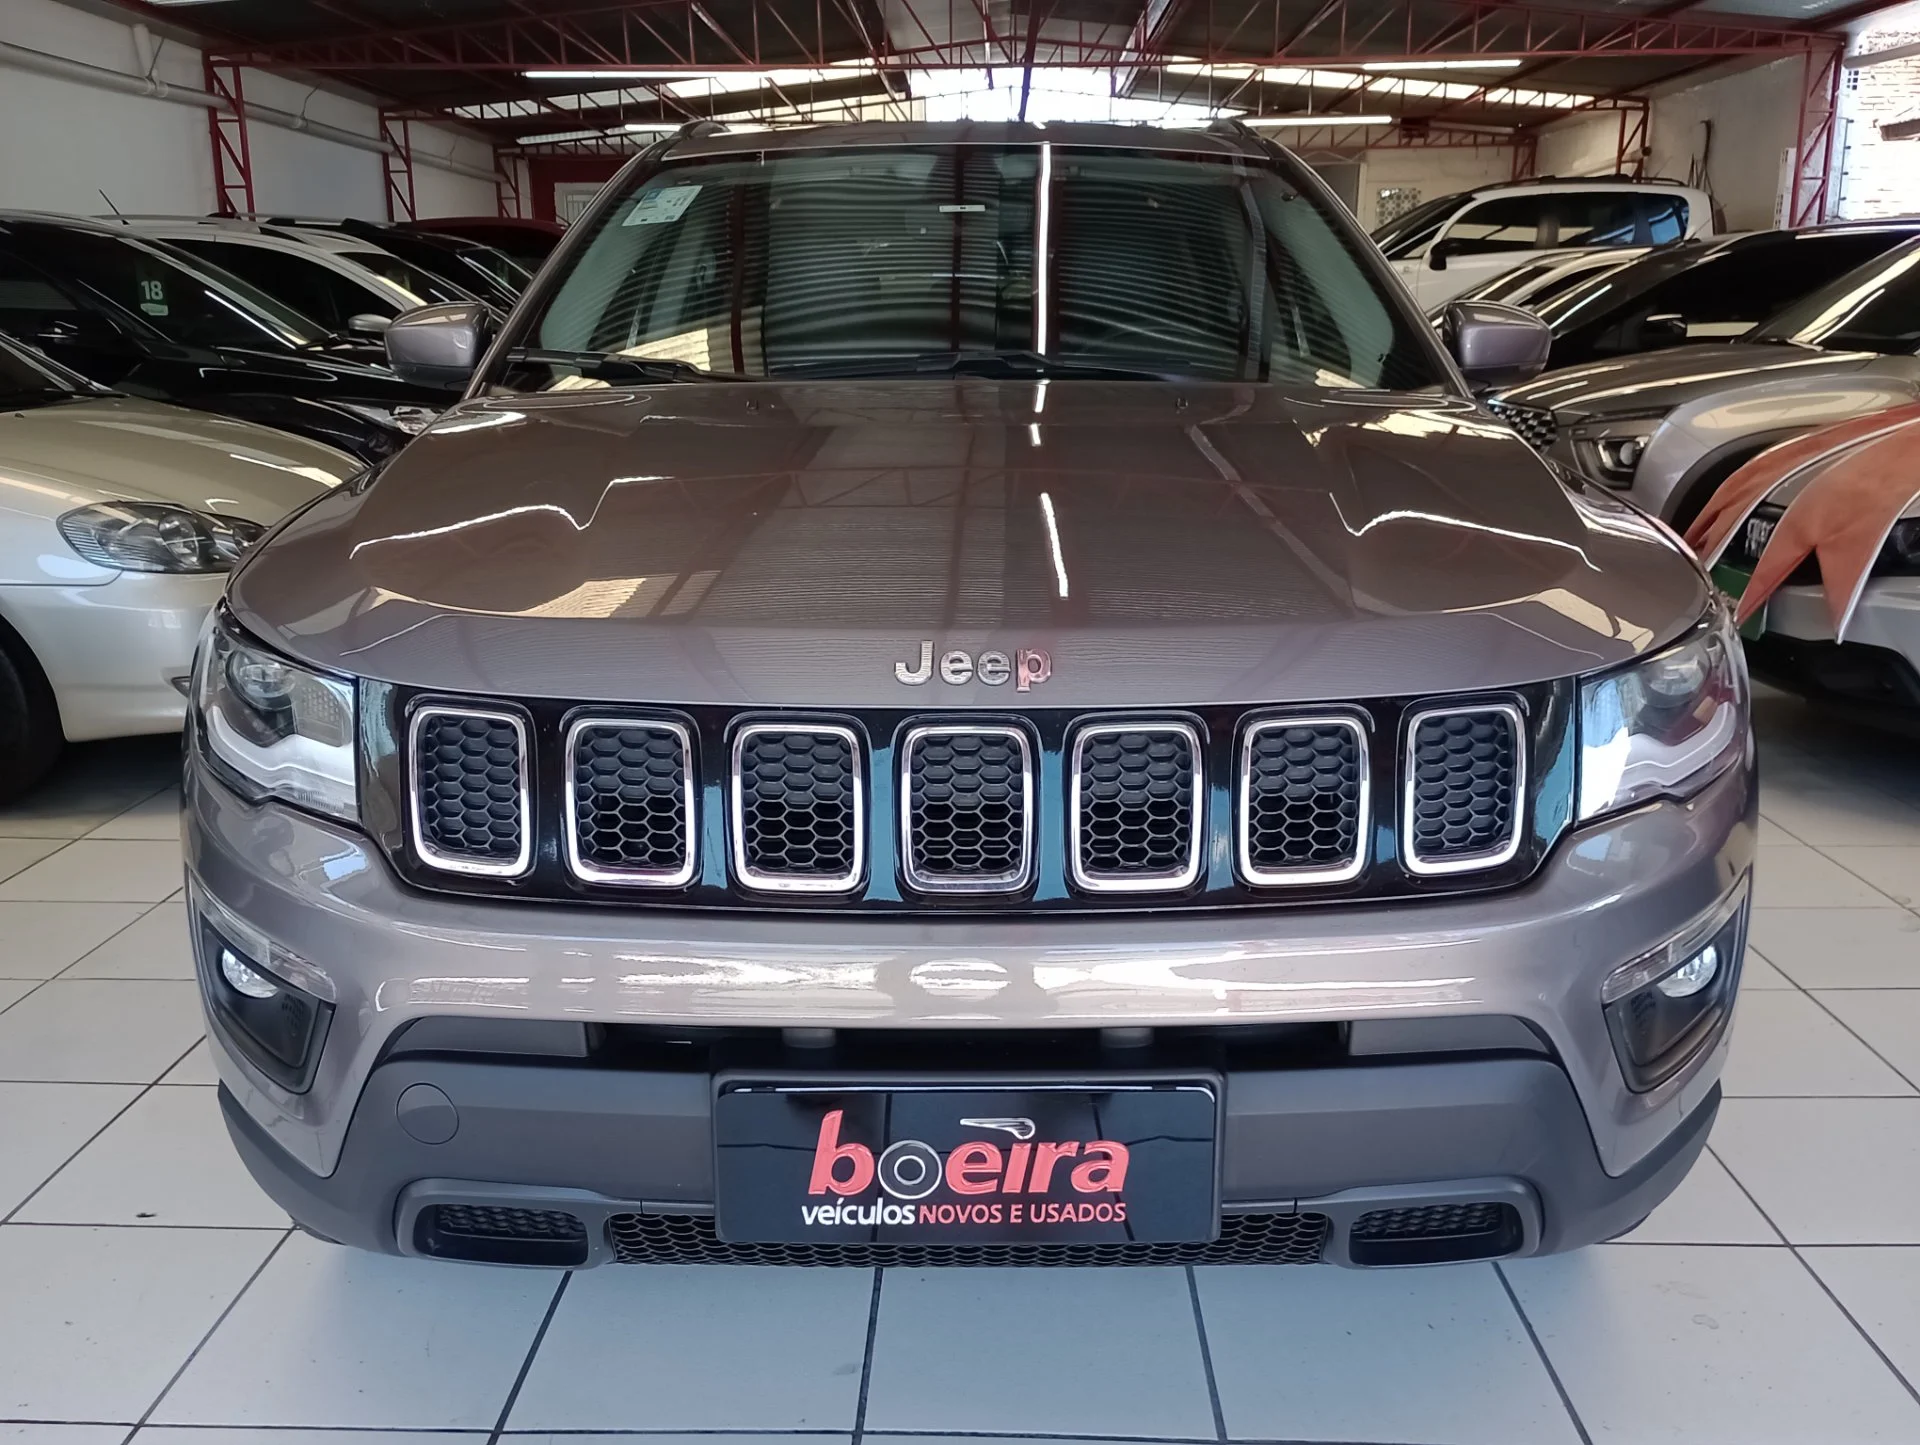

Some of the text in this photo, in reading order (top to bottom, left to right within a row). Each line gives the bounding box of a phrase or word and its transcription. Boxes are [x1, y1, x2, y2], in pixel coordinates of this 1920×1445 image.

[141, 281, 163, 300] 18
[894, 640, 1052, 692] Jeep
[808, 1110, 1130, 1199] boeira
[801, 1198, 1127, 1226] veículos NOVOS E USADOS
